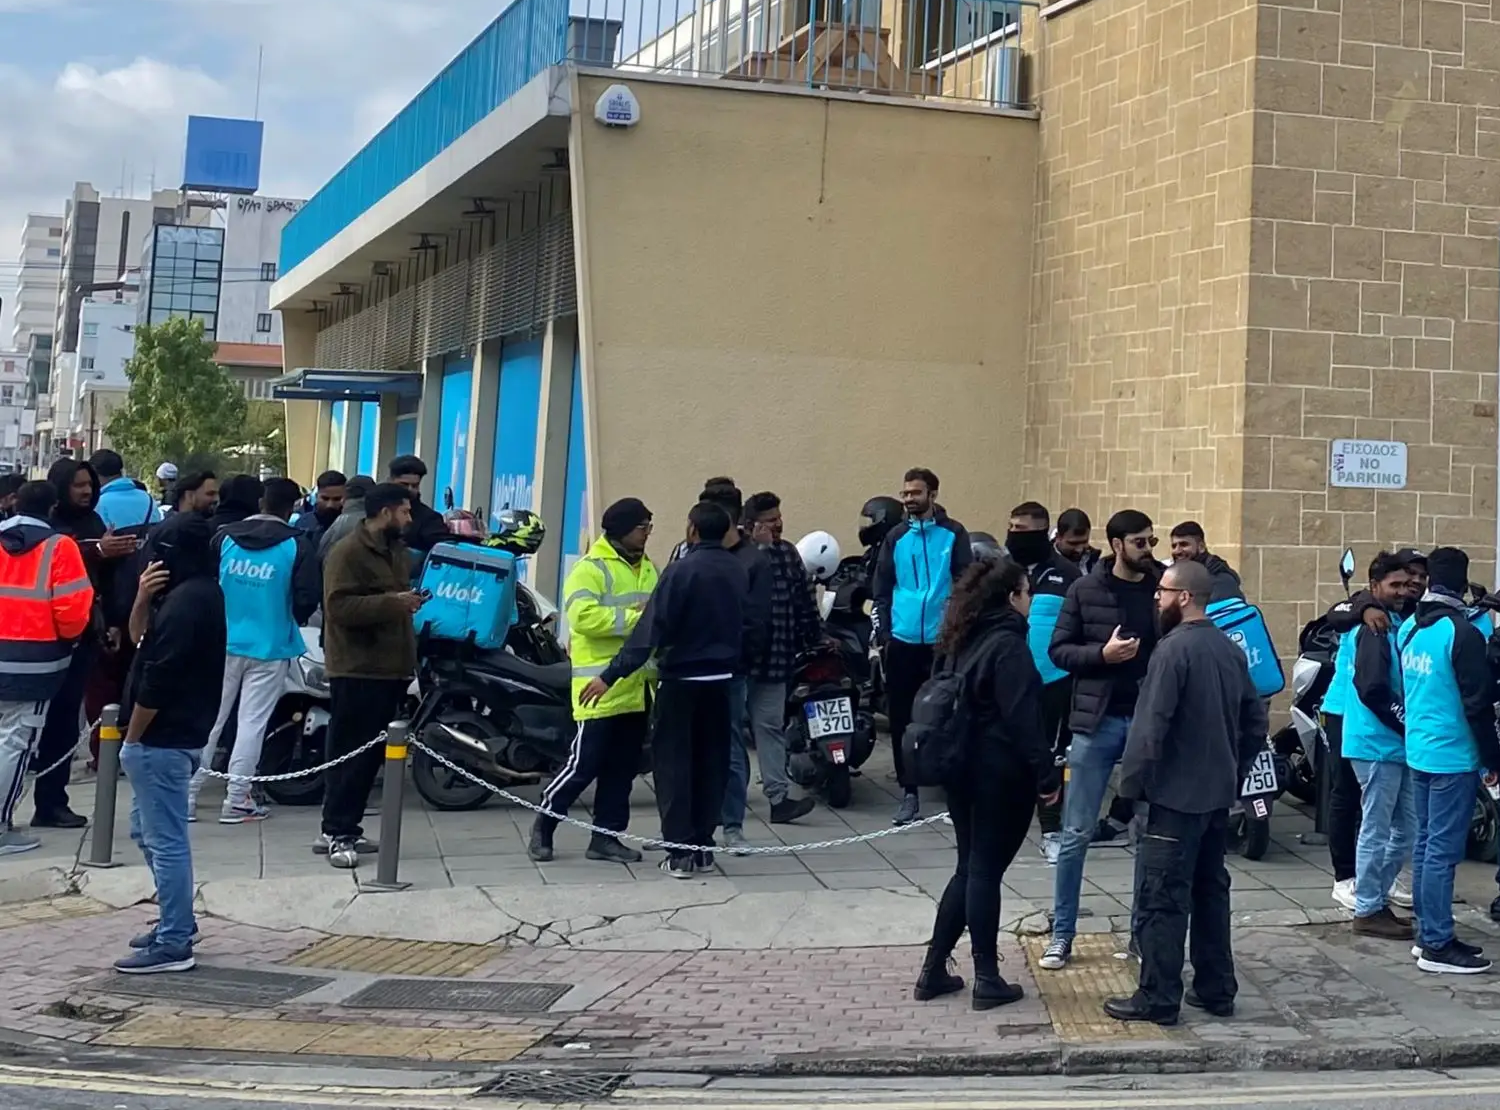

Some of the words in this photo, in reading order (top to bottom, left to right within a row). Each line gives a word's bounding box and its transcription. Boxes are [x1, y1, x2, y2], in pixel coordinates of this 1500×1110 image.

[1341, 442, 1400, 457] ΕΙΣΟΔΟΣ
[1360, 457, 1380, 469] NO
[1337, 472, 1401, 485] PARKING
[227, 558, 276, 580] Wolt
[436, 581, 485, 604] Wolt
[816, 699, 849, 716] NZE
[822, 715, 851, 733] 370
[1246, 771, 1275, 792] 750
[1255, 801, 1266, 816] E
